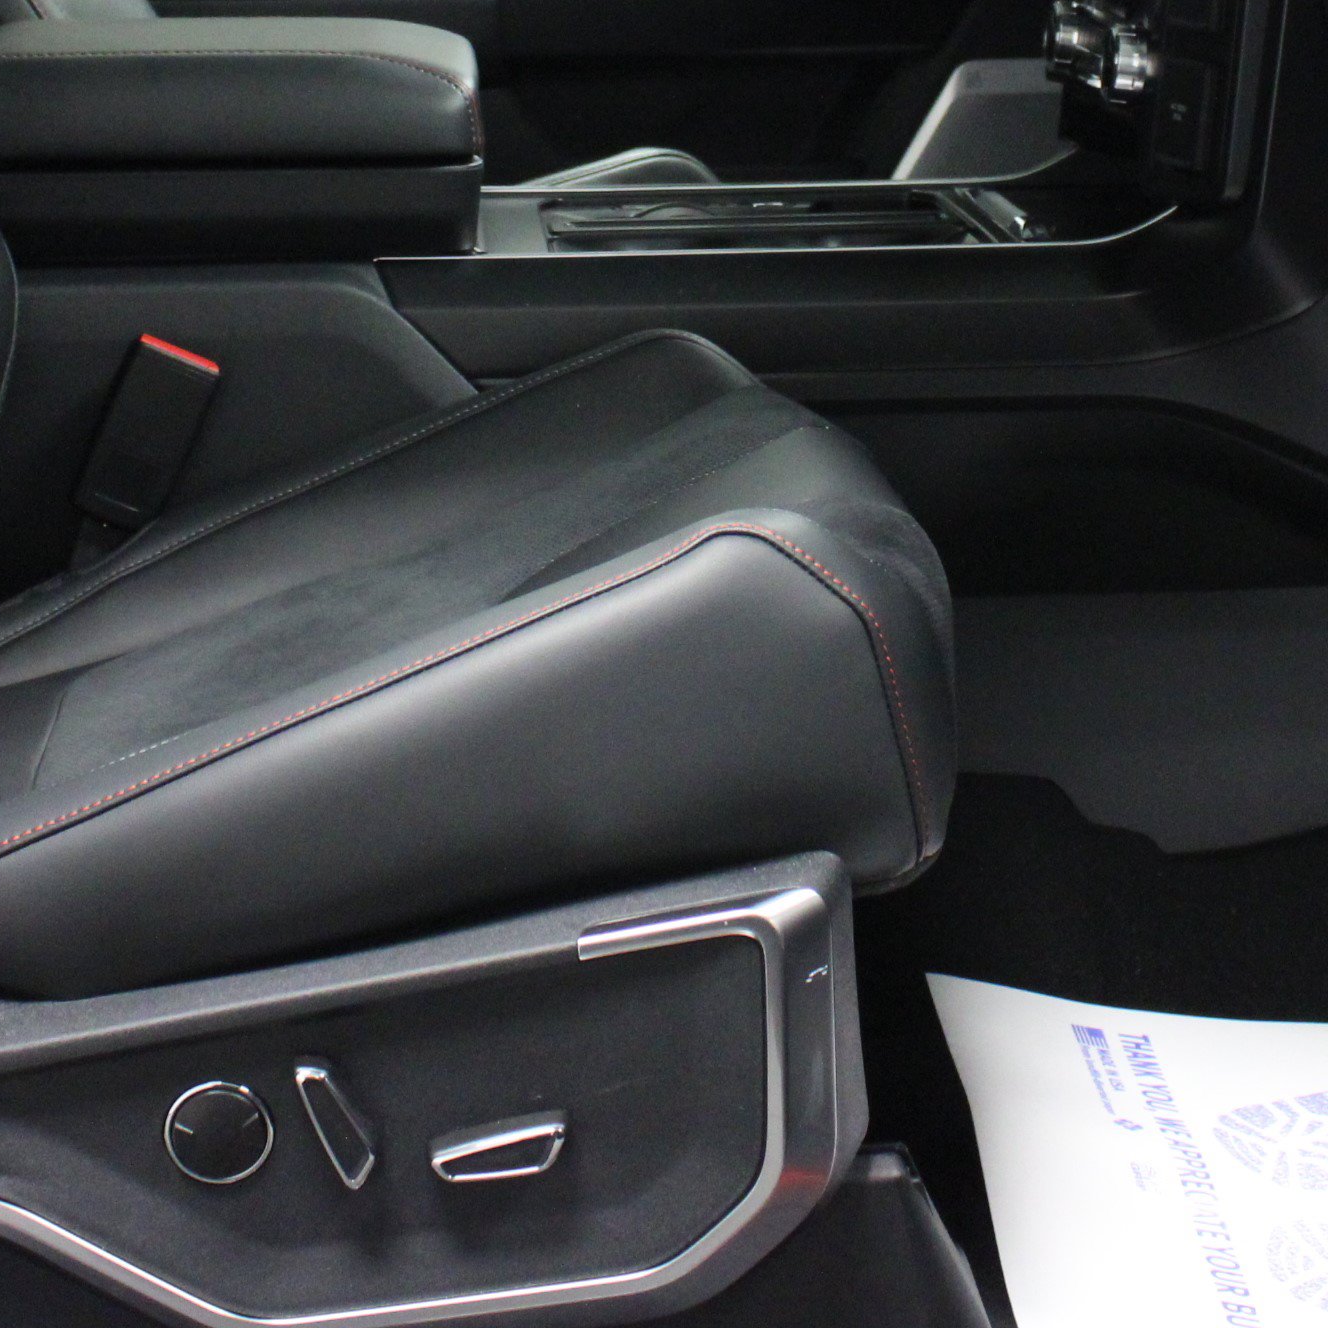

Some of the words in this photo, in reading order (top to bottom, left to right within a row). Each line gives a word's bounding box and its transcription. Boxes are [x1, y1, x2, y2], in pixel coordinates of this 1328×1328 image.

[1118, 1032, 1166, 1082] THANK
[1138, 1082, 1179, 1112] YOU,
[1153, 1116, 1193, 1139] WE
[1164, 1136, 1231, 1242] APPRECIATE
[1201, 1245, 1250, 1298] YOUR
